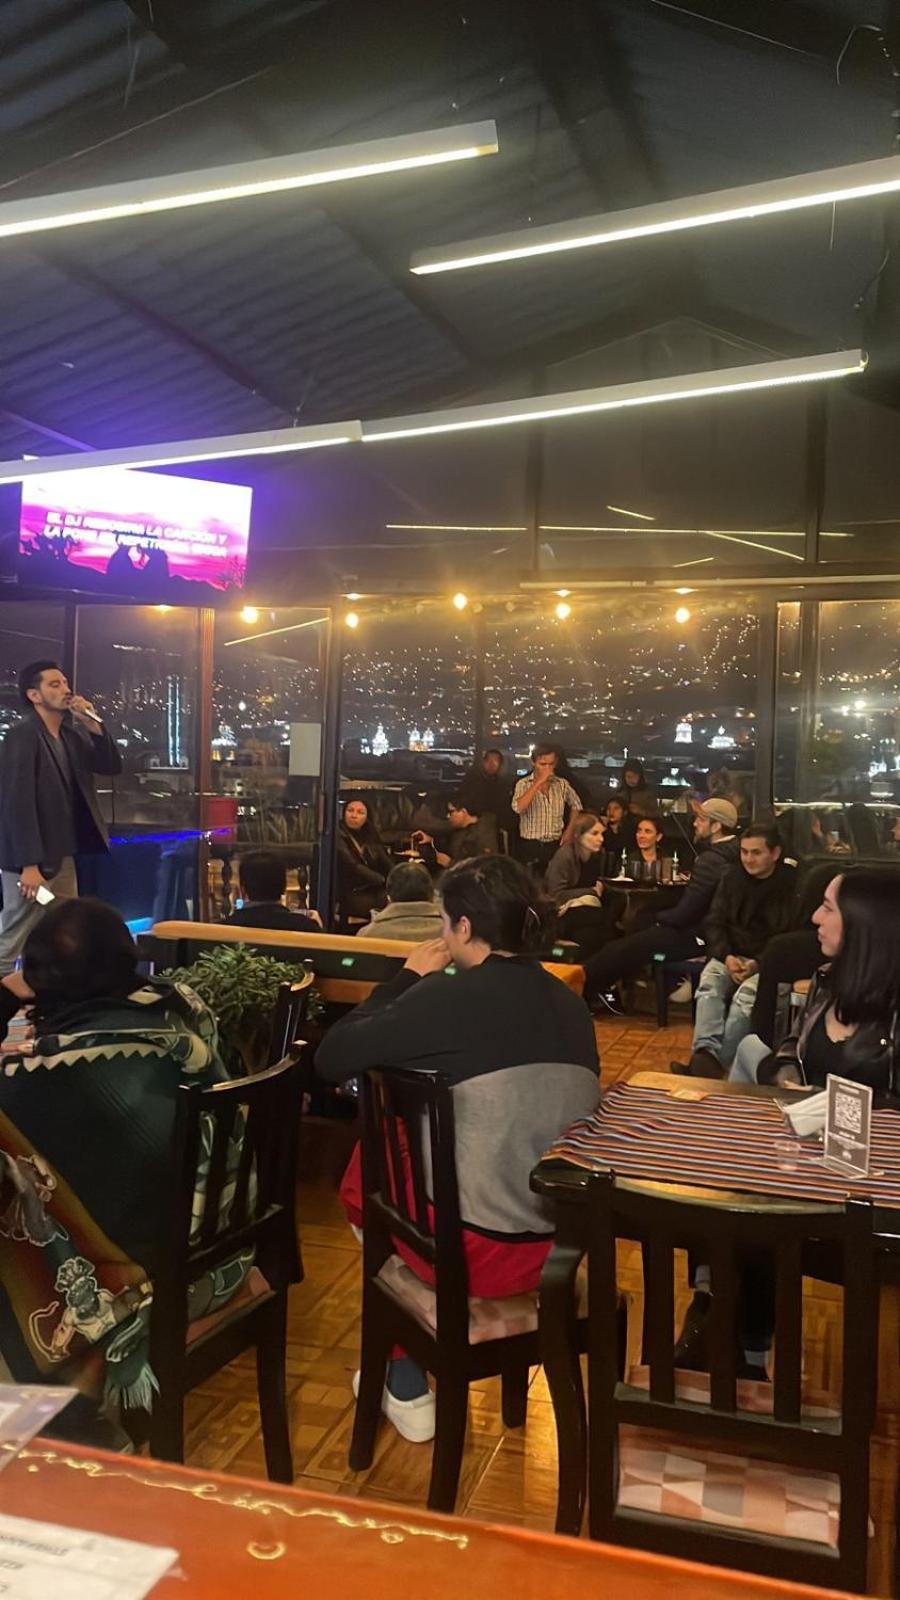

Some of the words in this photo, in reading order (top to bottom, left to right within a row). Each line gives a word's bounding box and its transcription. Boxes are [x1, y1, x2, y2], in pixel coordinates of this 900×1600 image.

[44, 524, 61, 539] LA
[65, 514, 82, 527] DJ
[145, 524, 163, 539] LA
